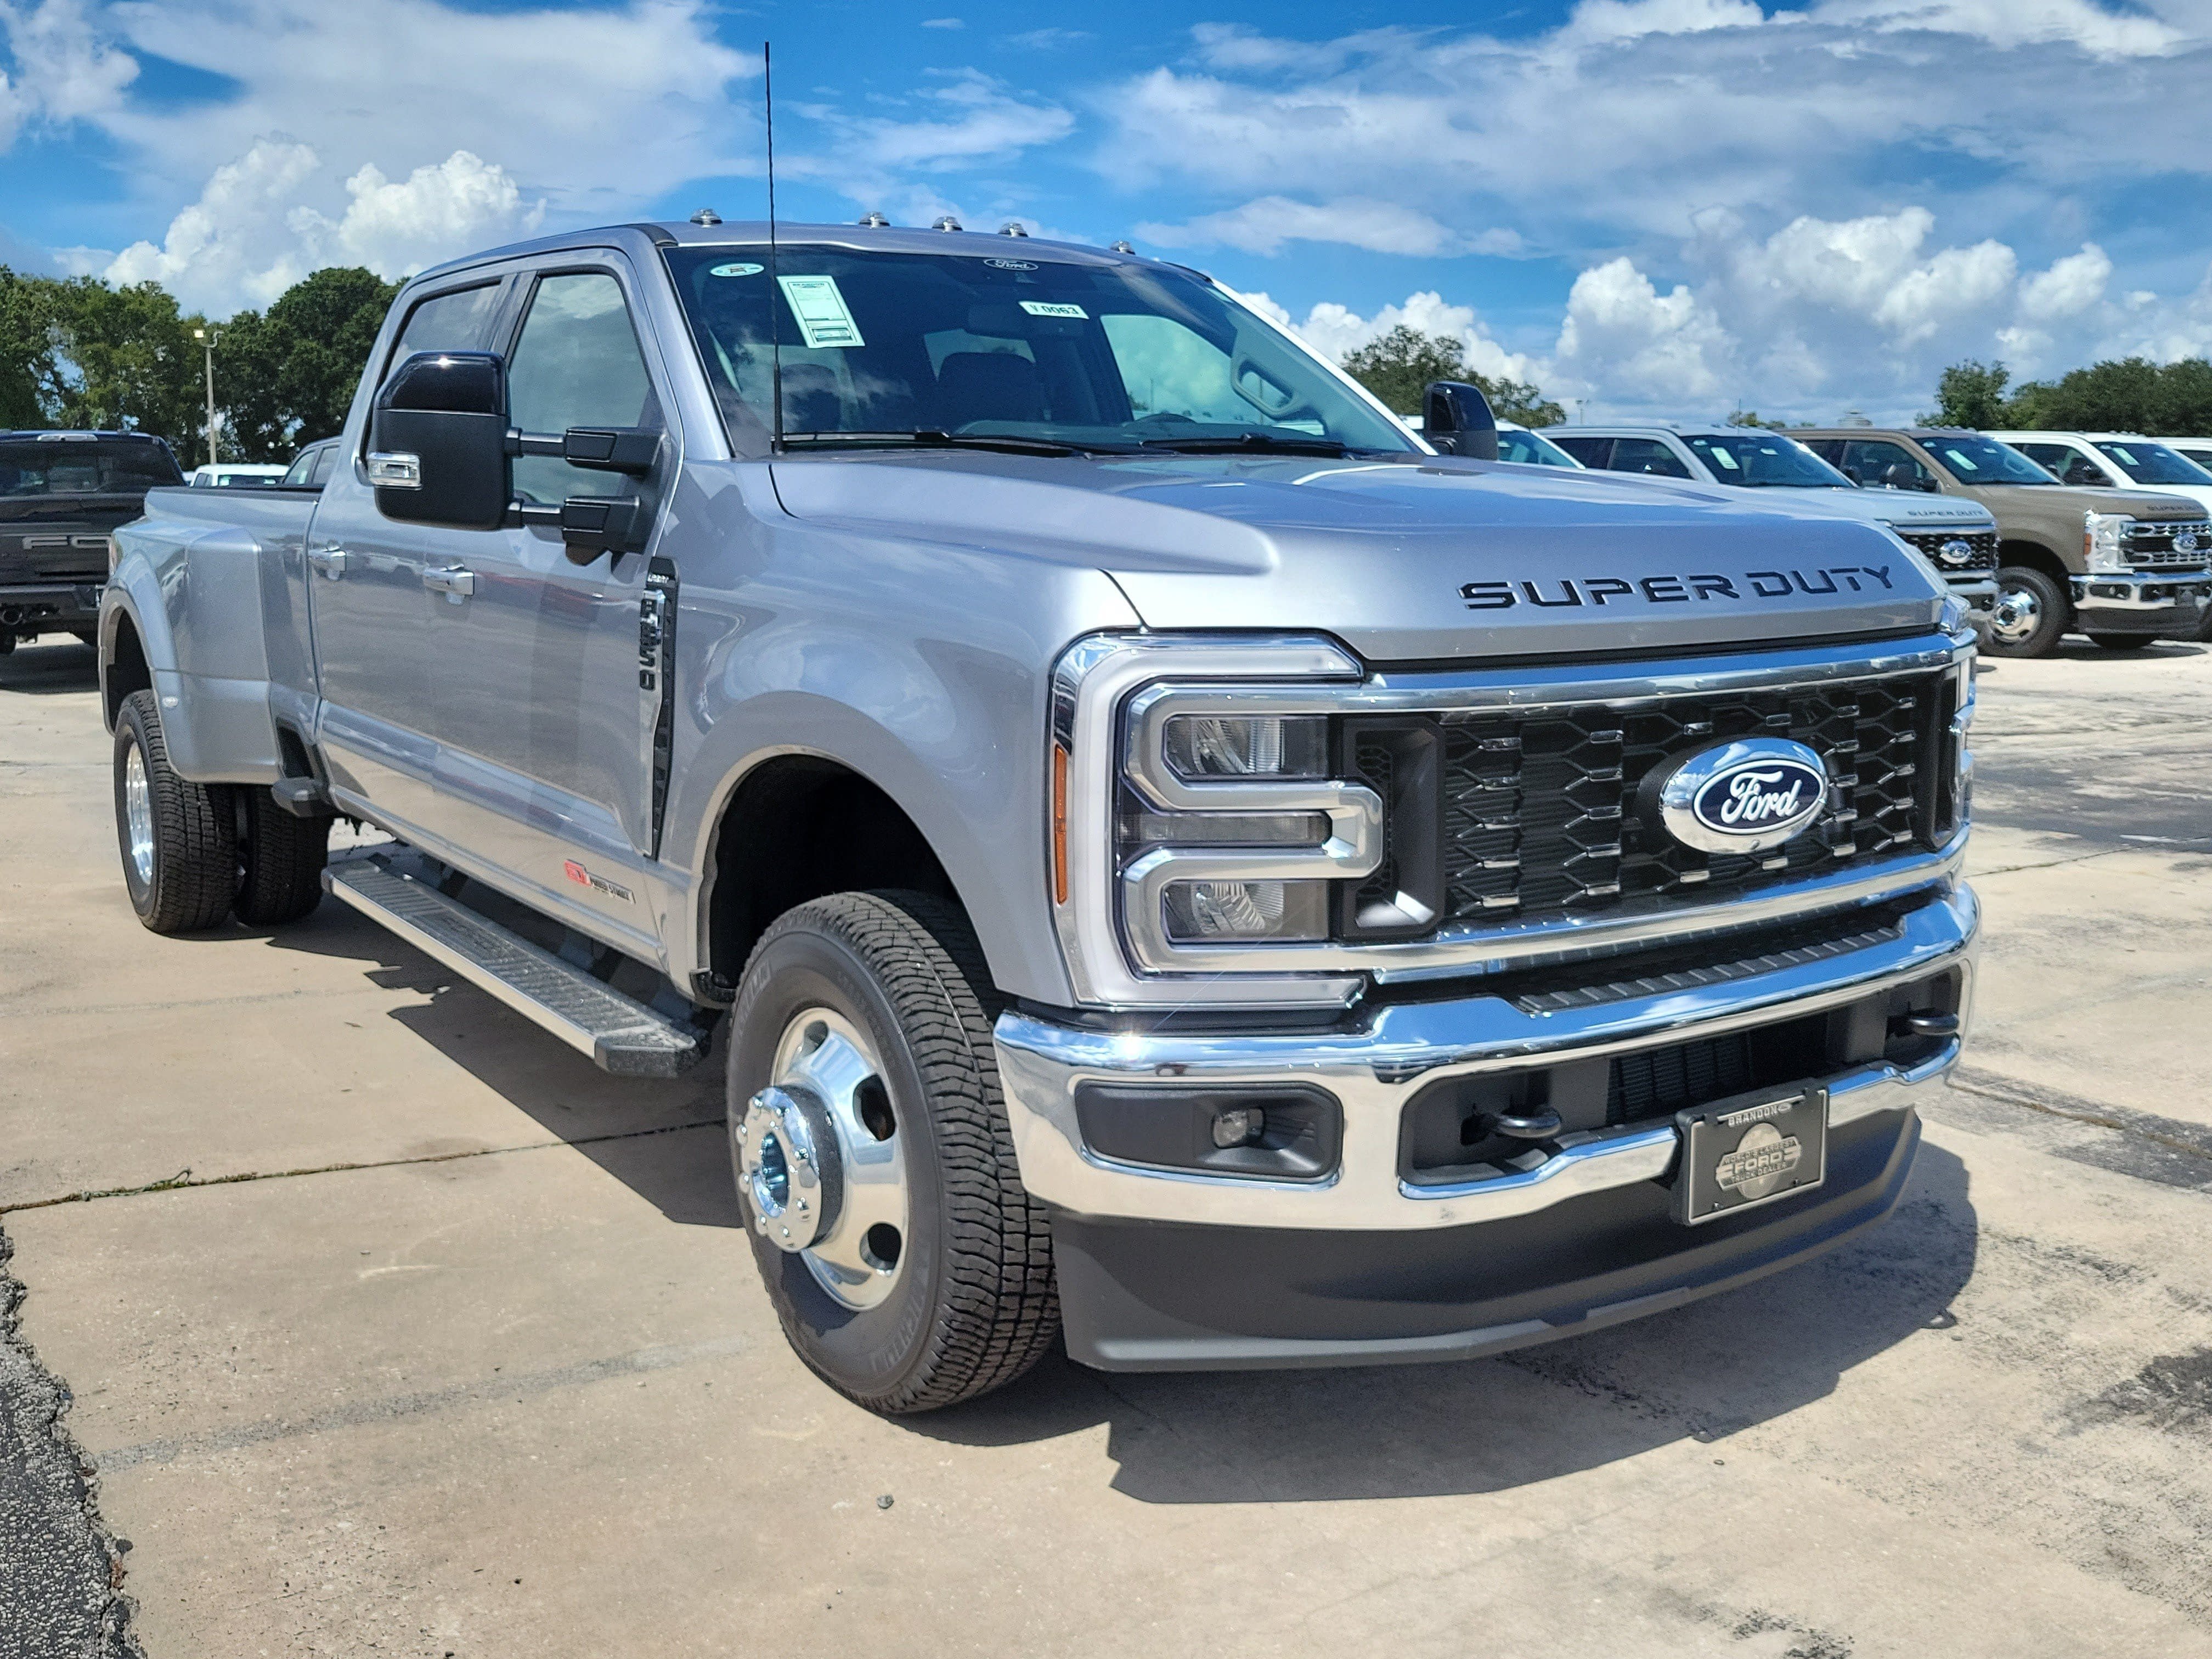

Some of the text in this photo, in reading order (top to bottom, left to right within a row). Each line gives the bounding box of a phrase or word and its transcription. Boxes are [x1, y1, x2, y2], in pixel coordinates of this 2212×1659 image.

[995, 259, 1030, 269] Ford
[1041, 306, 1079, 314] 0063
[1458, 566, 1892, 609] SUPER DUTY
[1720, 770, 1803, 823] Ford
[1728, 1105, 1778, 1127] BRANDON
[1734, 1151, 1782, 1175] FORD
[1757, 1162, 1787, 1176] DEALER
